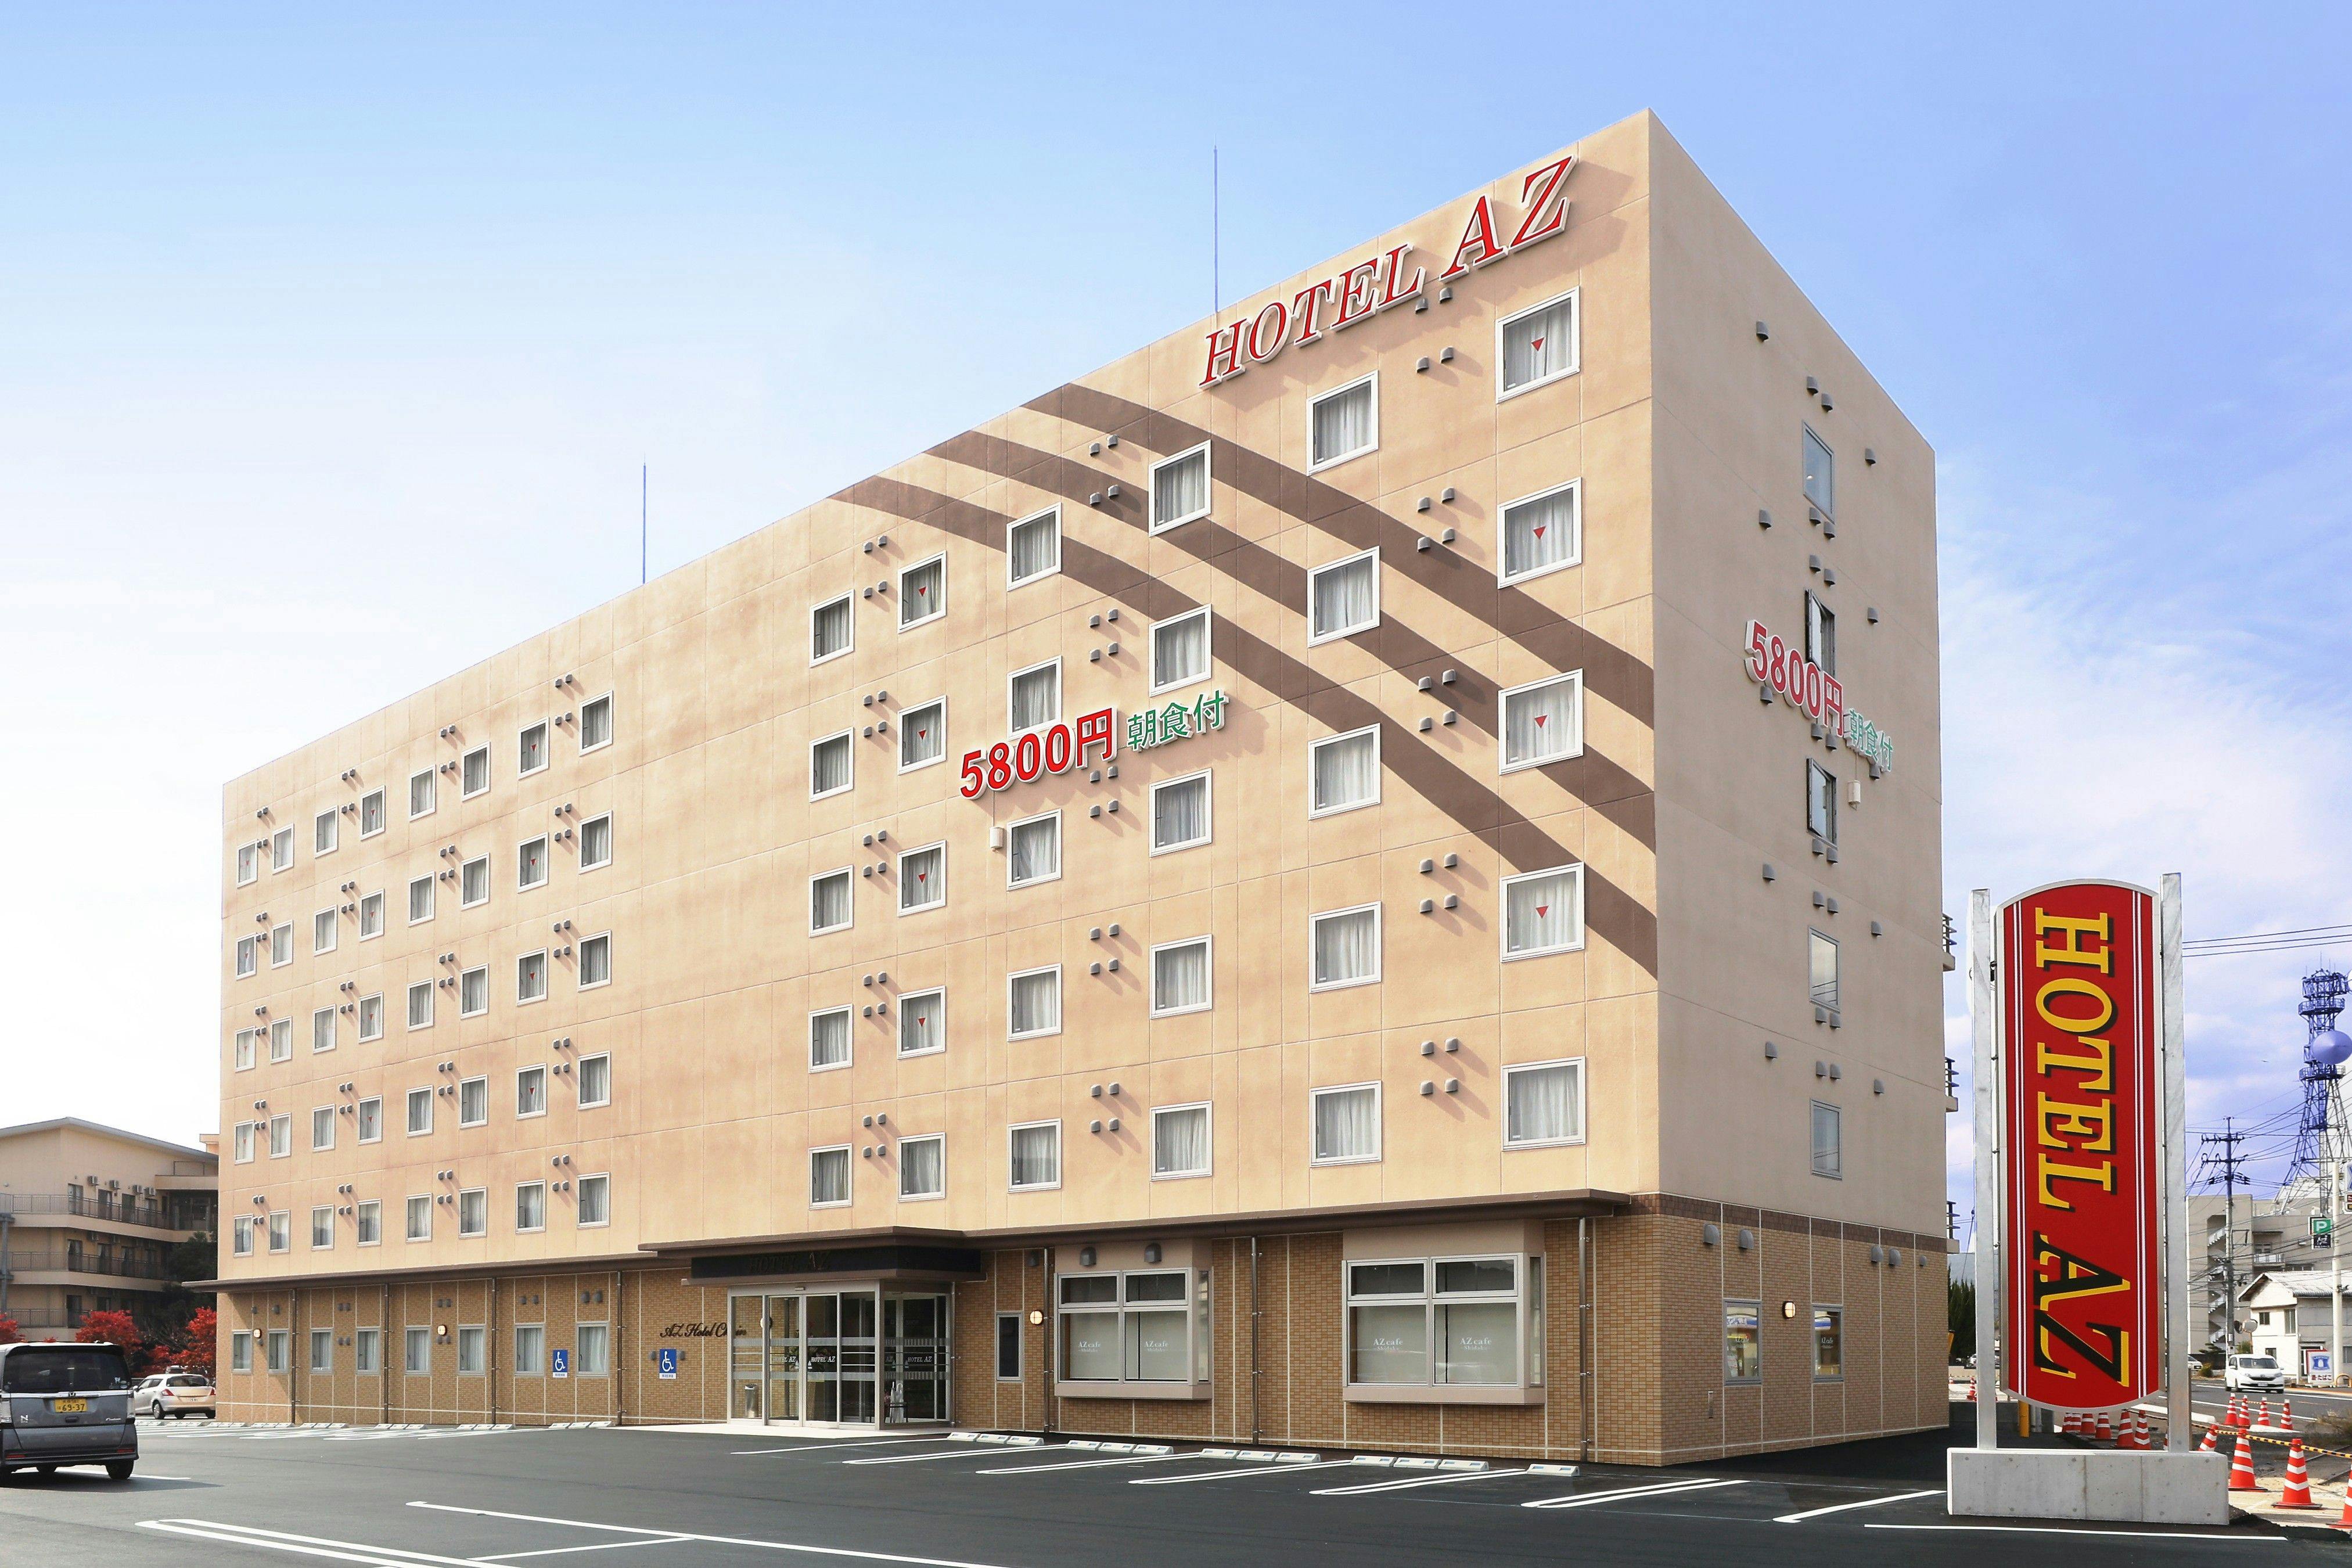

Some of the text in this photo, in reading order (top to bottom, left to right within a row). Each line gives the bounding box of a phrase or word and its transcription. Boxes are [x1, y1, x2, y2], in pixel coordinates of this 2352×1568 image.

[1199, 154, 1577, 389] HOTEL AZ
[959, 689, 1229, 800] 5800円 朝食付
[1745, 619, 1893, 772] 5800円 朝食付
[2033, 907, 2131, 1387] HOTEL AZ
[2316, 1221, 2328, 1232] P
[660, 1324, 685, 1337] AZ
[684, 1322, 717, 1337] Hotel
